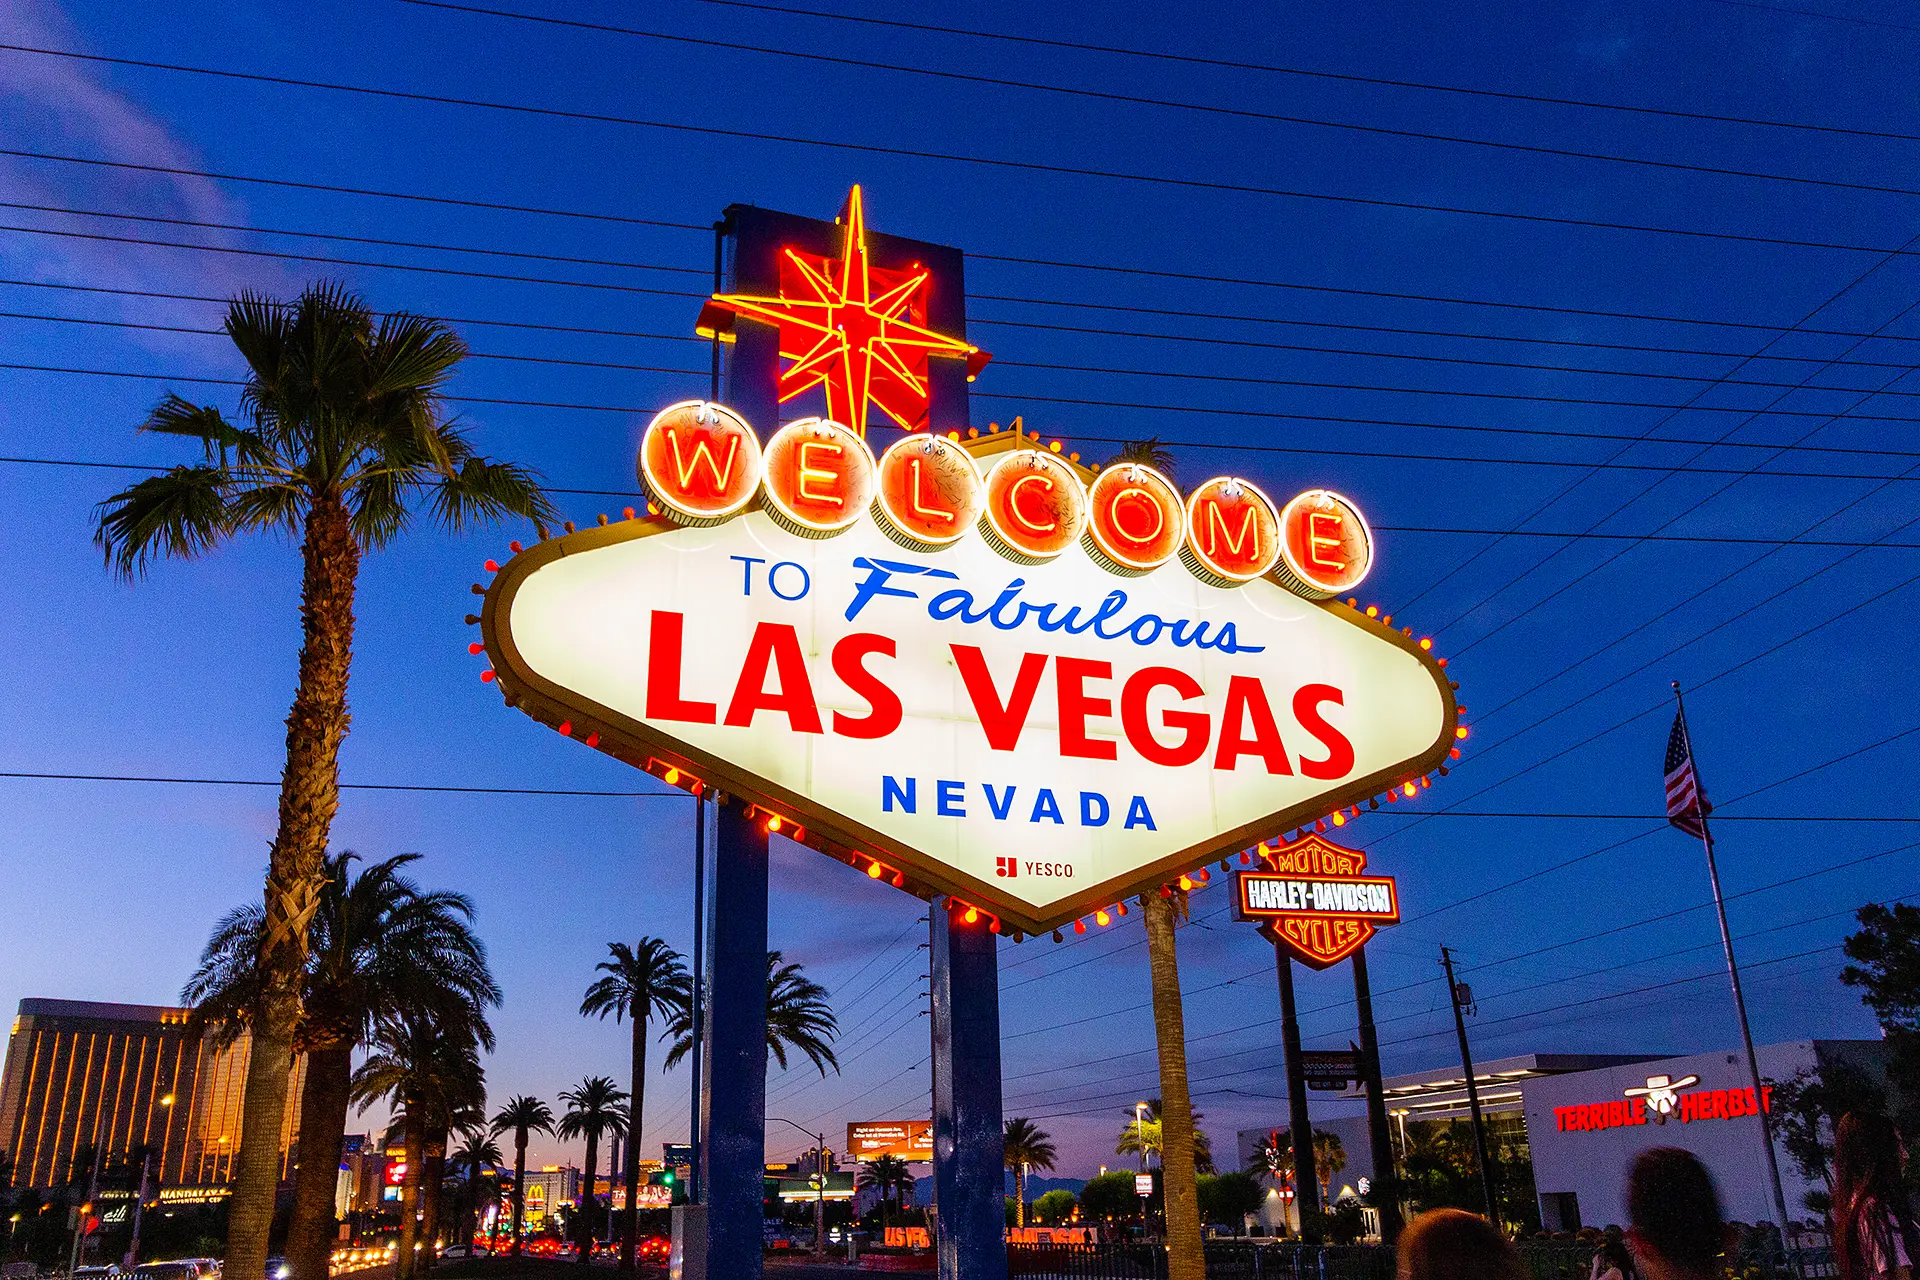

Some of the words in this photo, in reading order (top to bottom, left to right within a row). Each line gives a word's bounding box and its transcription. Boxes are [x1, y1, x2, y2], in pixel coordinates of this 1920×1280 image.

[664, 424, 1346, 572] WELCOME
[730, 554, 812, 601] TO
[845, 556, 1266, 655] Fabulous
[645, 609, 905, 741] LAS
[947, 642, 1357, 782] VEGAS
[880, 774, 1159, 833] NEVADA
[1025, 861, 1074, 878] YESCO
[1278, 843, 1353, 875] MOTOR
[1247, 880, 1391, 913] HARLEY-DAVIDSON
[1284, 918, 1360, 955] CYCLES
[1553, 1098, 1647, 1132] TERRIBLE
